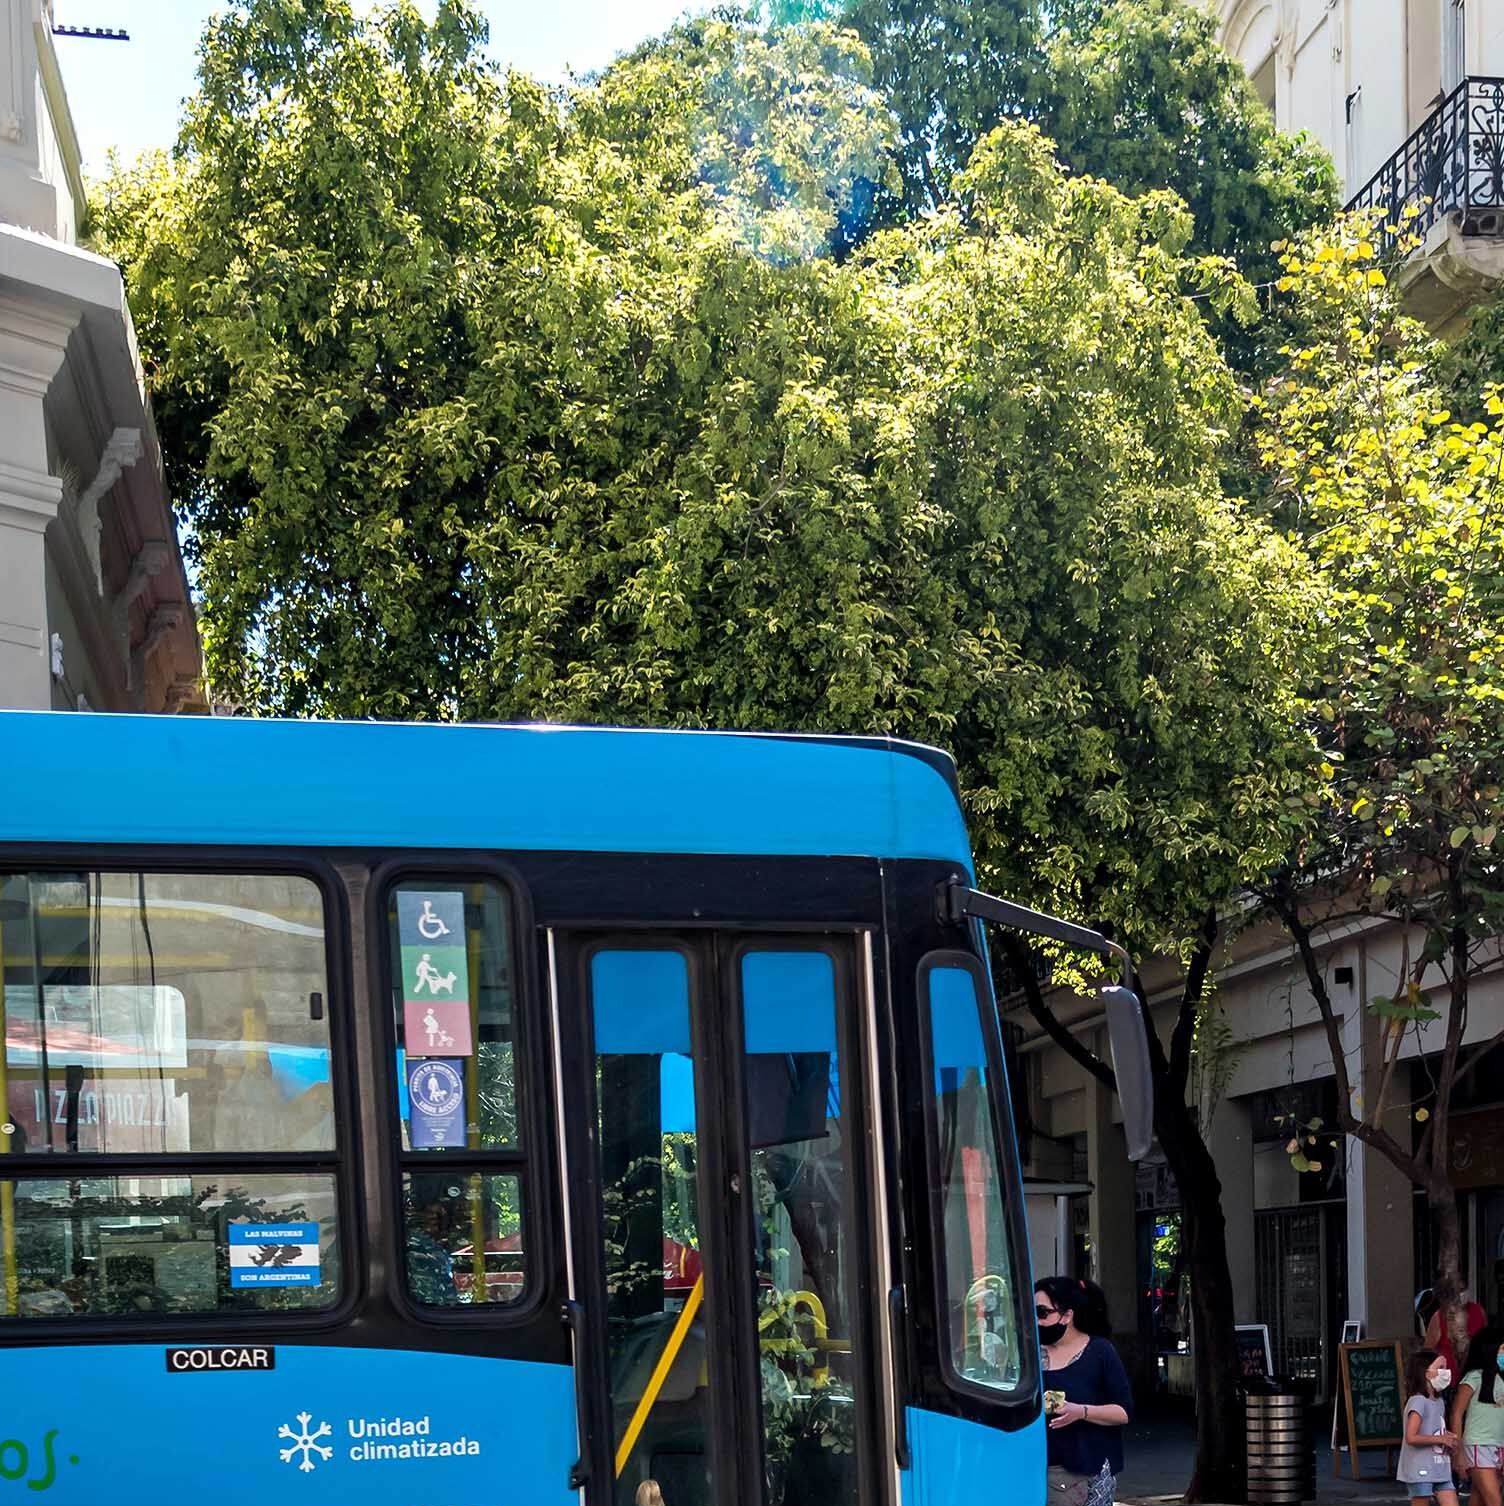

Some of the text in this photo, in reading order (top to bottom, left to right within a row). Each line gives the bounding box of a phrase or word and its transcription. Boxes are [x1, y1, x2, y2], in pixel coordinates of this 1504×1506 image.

[172, 1349, 268, 1369] COLCAR
[348, 1416, 430, 1439] Unidad
[349, 1437, 480, 1462] climatizada
